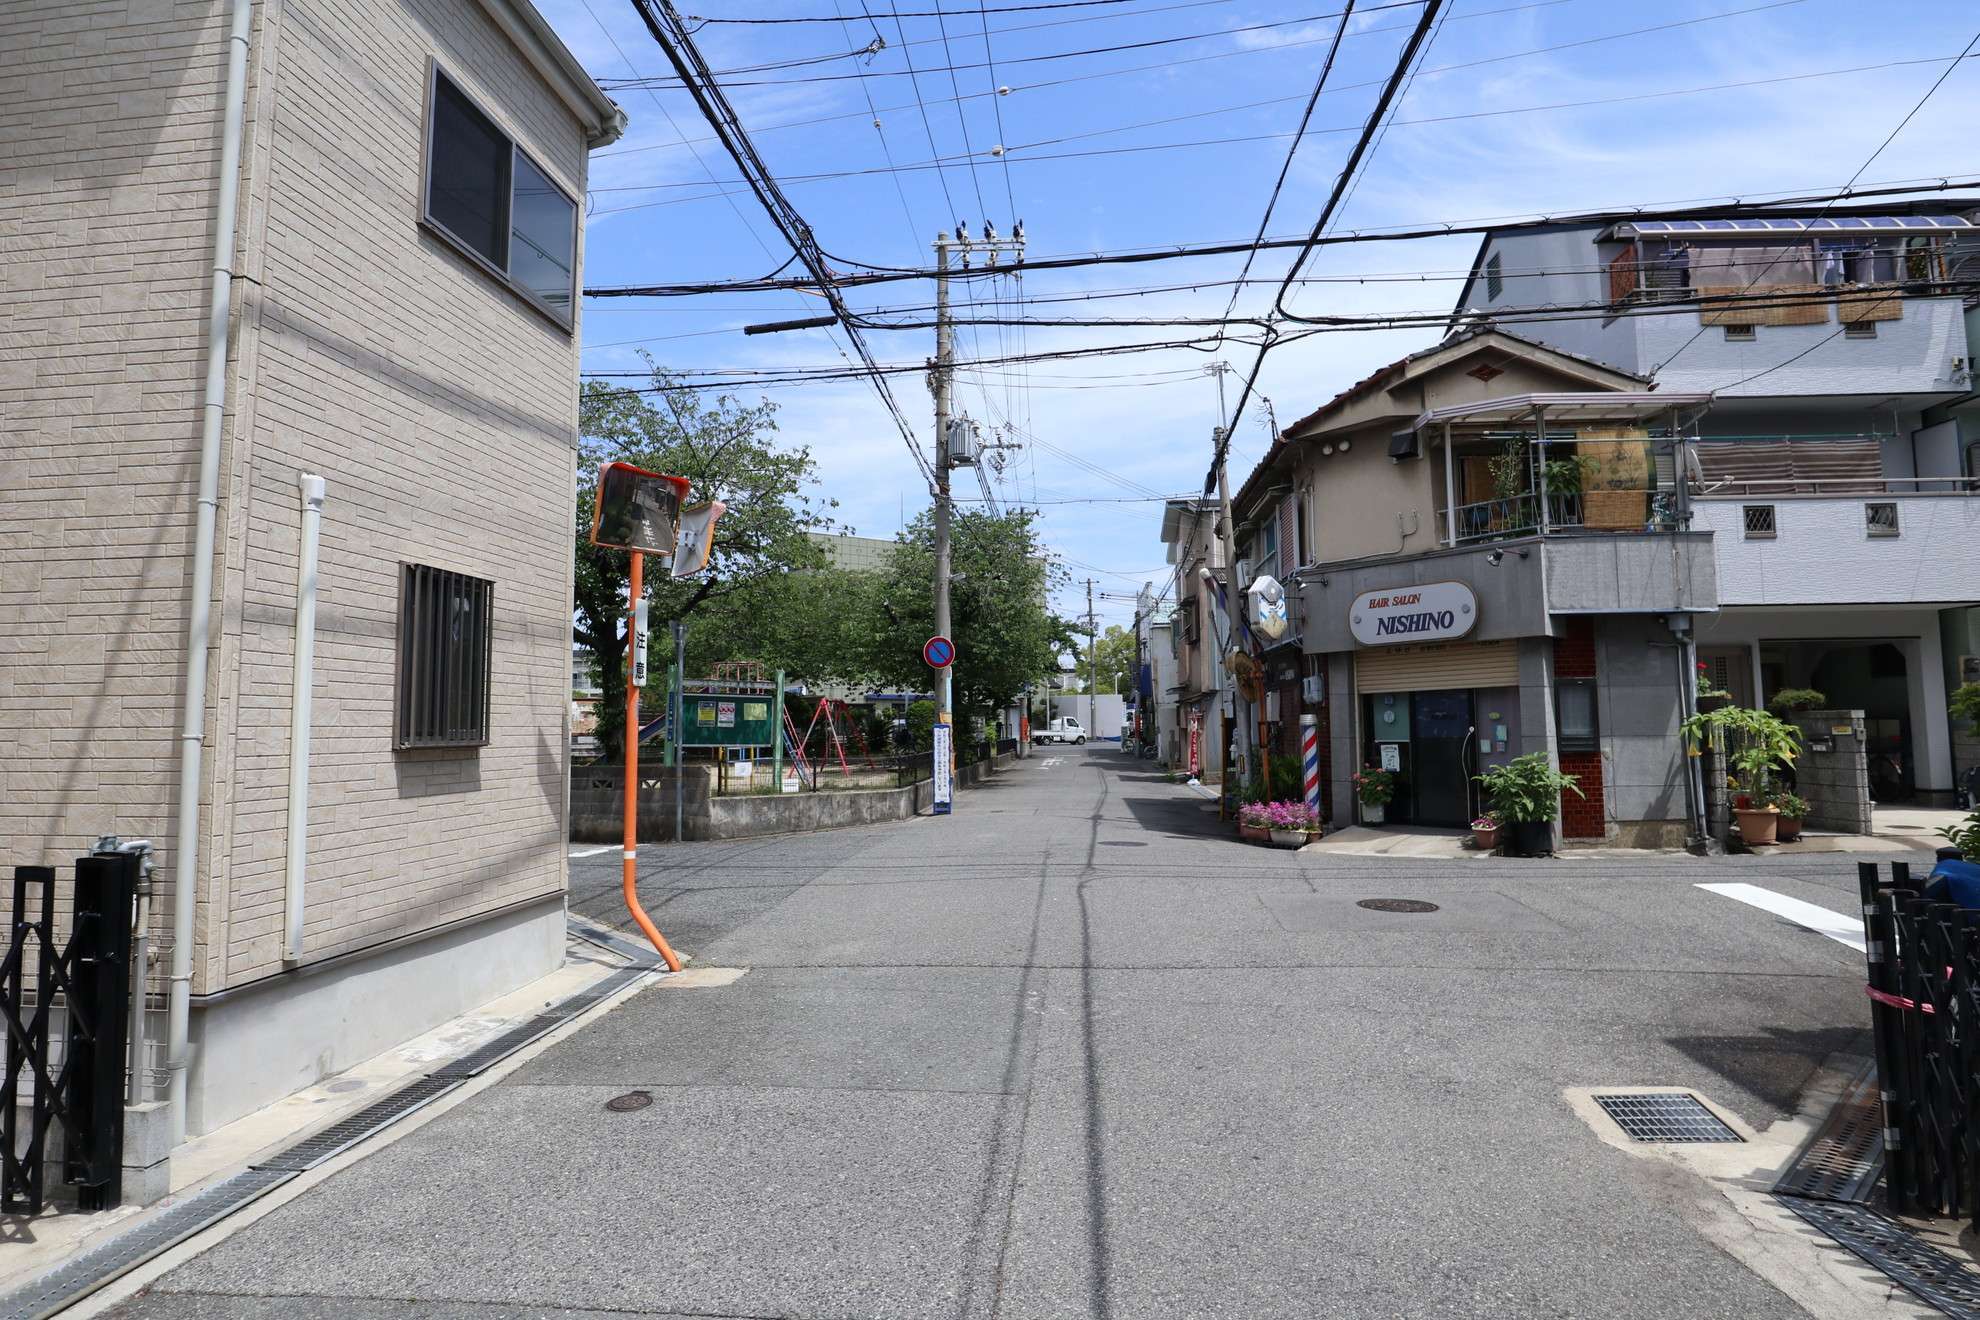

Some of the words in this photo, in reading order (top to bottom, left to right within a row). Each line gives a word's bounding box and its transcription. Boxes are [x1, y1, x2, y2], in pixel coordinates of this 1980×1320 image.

[1368, 598, 1389, 609] HAIR
[1392, 593, 1421, 606] SALON
[1377, 611, 1454, 635] NISHINO
